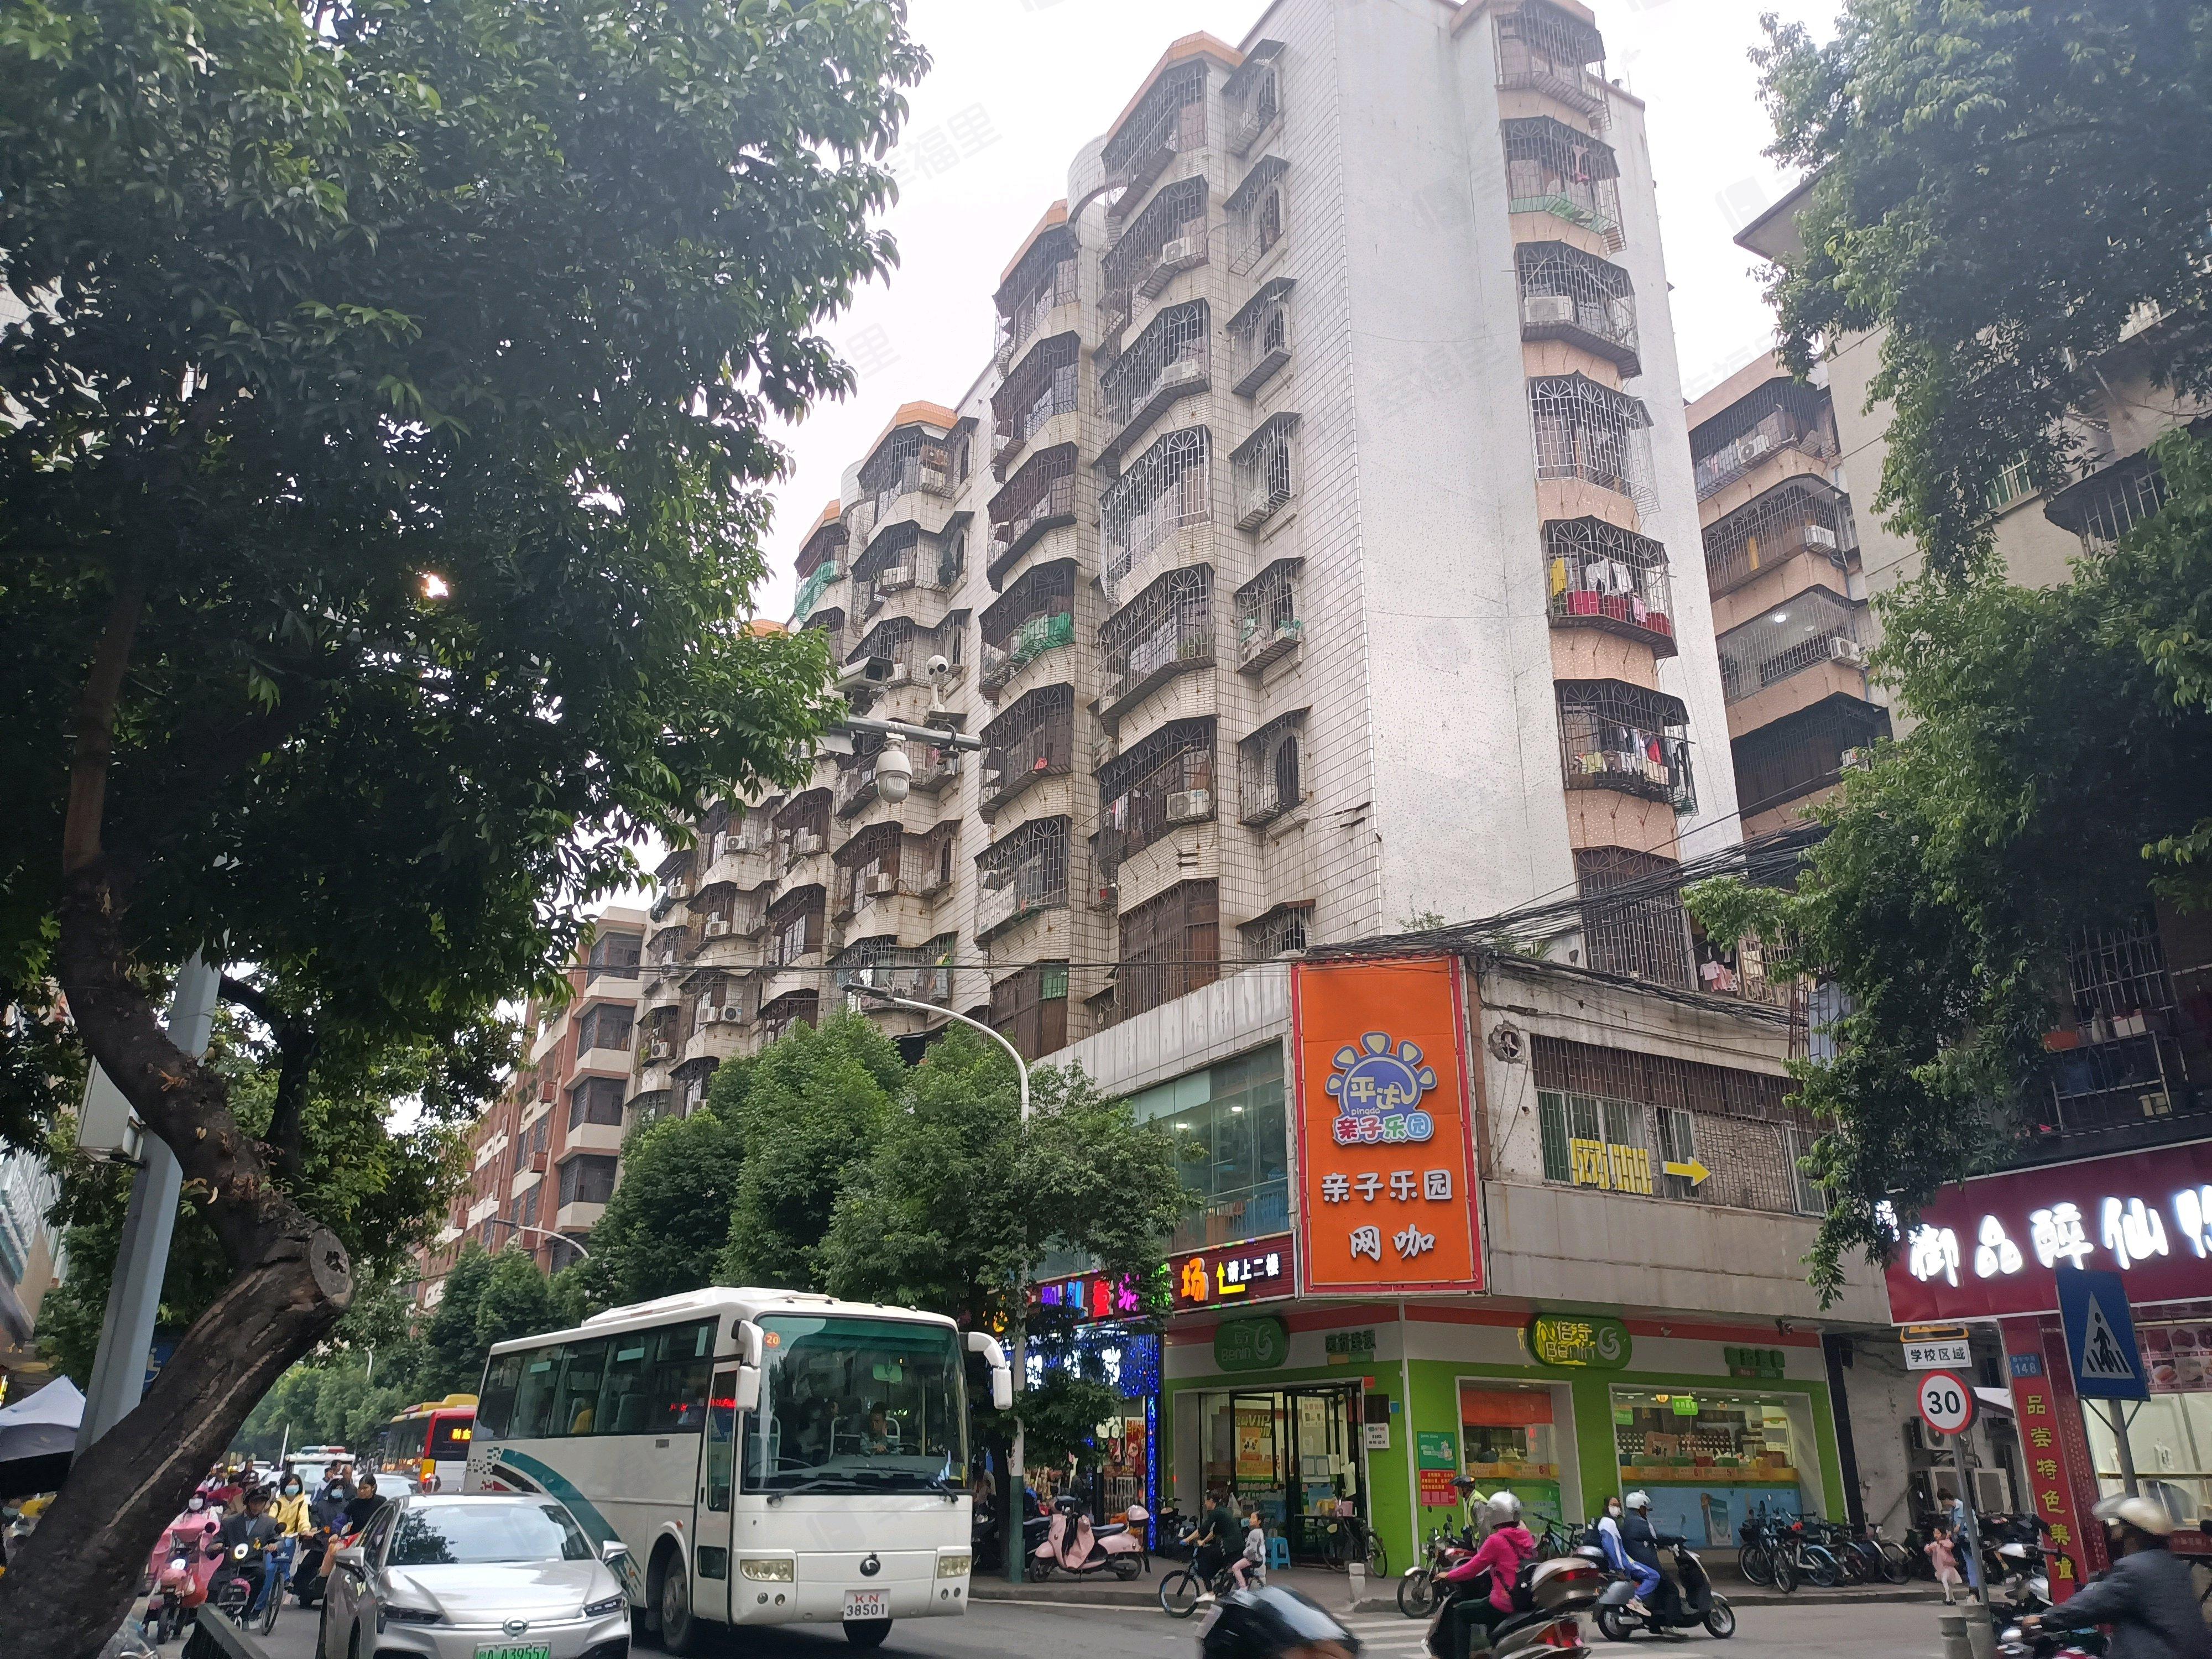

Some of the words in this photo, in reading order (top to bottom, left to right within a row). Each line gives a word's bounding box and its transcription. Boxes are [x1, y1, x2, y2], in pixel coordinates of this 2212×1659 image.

[1350, 1076, 1401, 1110] 平达
[1351, 1107, 1381, 1116] pingda
[1335, 1114, 1431, 1140] 亲子乐园
[1321, 1168, 1453, 1203] 亲子乐园
[1349, 1223, 1436, 1261] 网咖
[766, 1335, 779, 1344] 20
[1910, 1347, 1965, 1363] 学校区域
[2015, 1362, 2037, 1374] 148
[1927, 1390, 1960, 1415] 30
[846, 1603, 885, 1616] 38501
